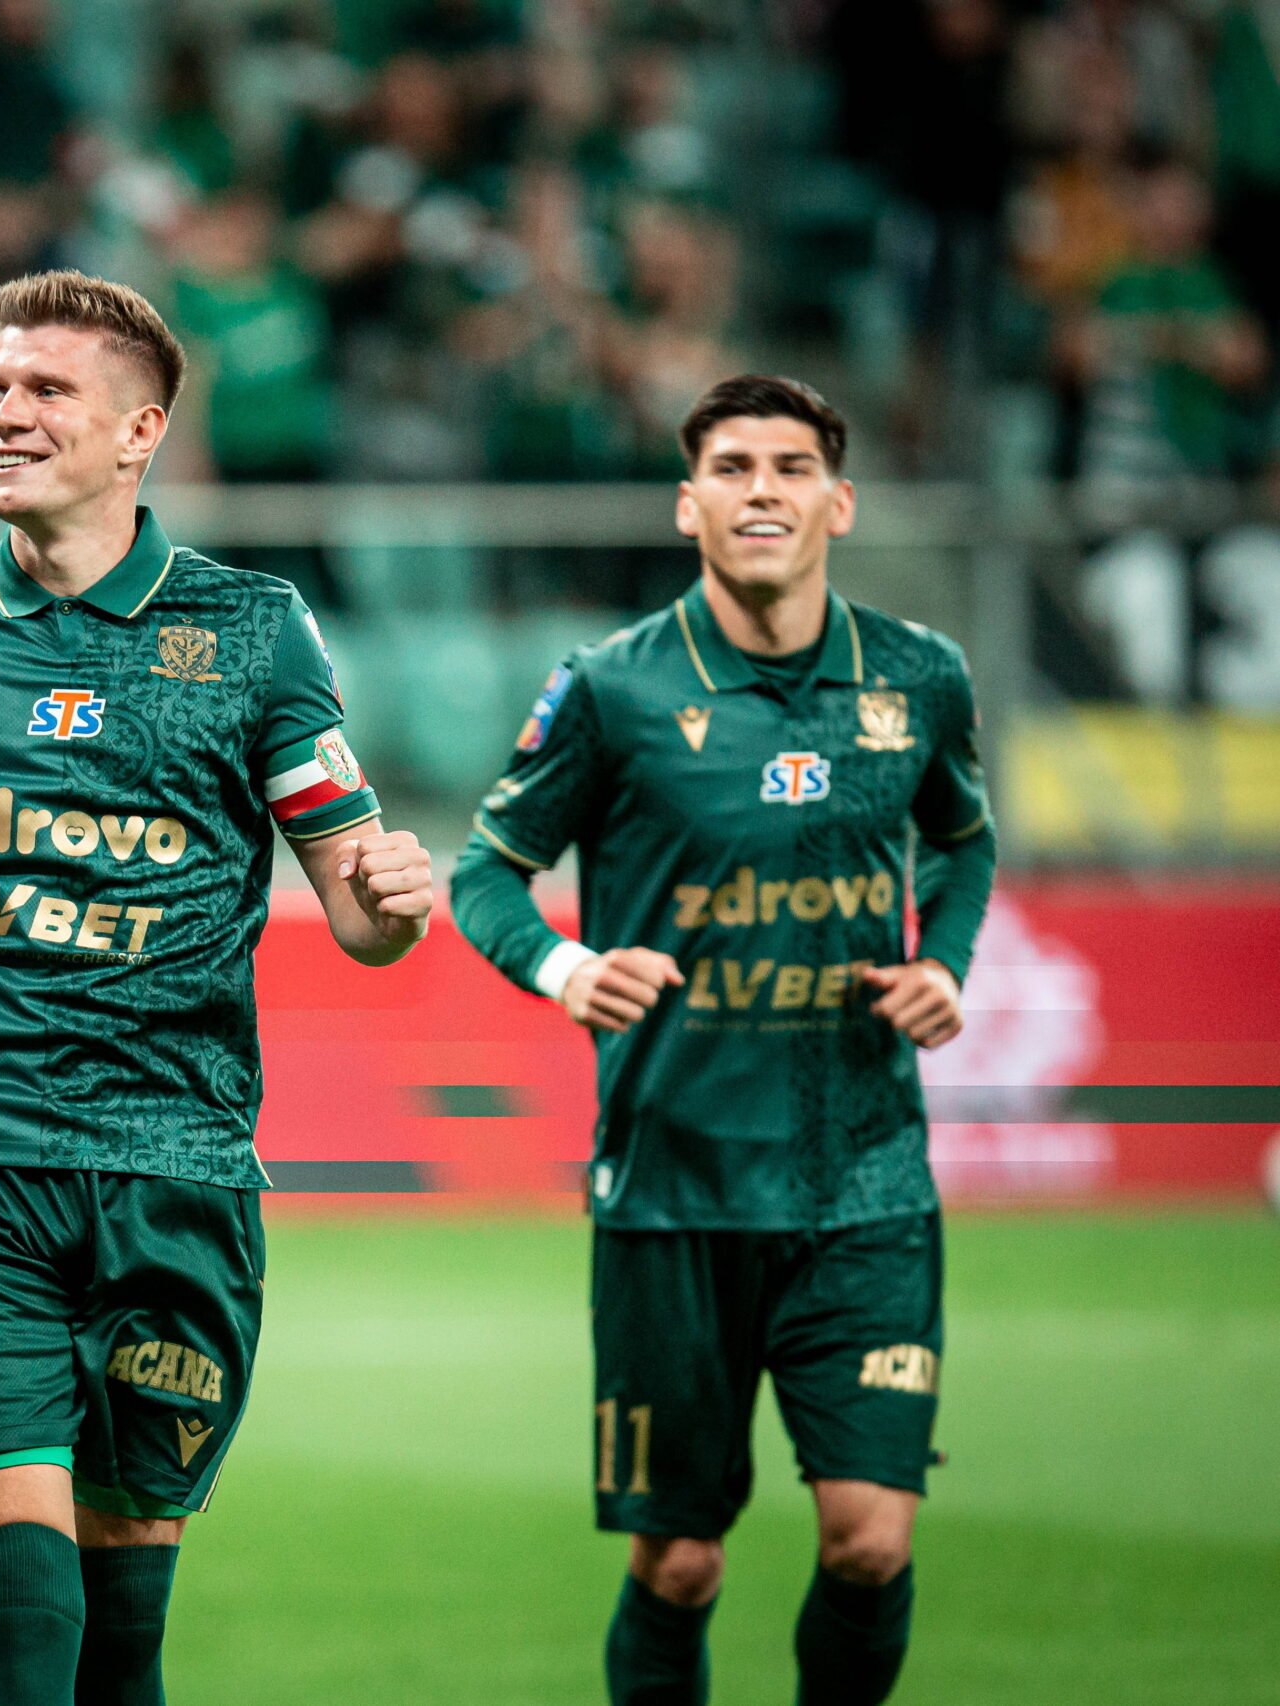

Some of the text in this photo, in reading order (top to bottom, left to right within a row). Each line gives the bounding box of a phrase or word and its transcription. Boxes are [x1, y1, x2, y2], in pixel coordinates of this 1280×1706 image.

[27, 688, 106, 740] STS
[760, 752, 829, 804] STS
[673, 867, 894, 929] zdrovo
[106, 1341, 223, 1402] ACANA
[595, 1397, 652, 1494] 11
